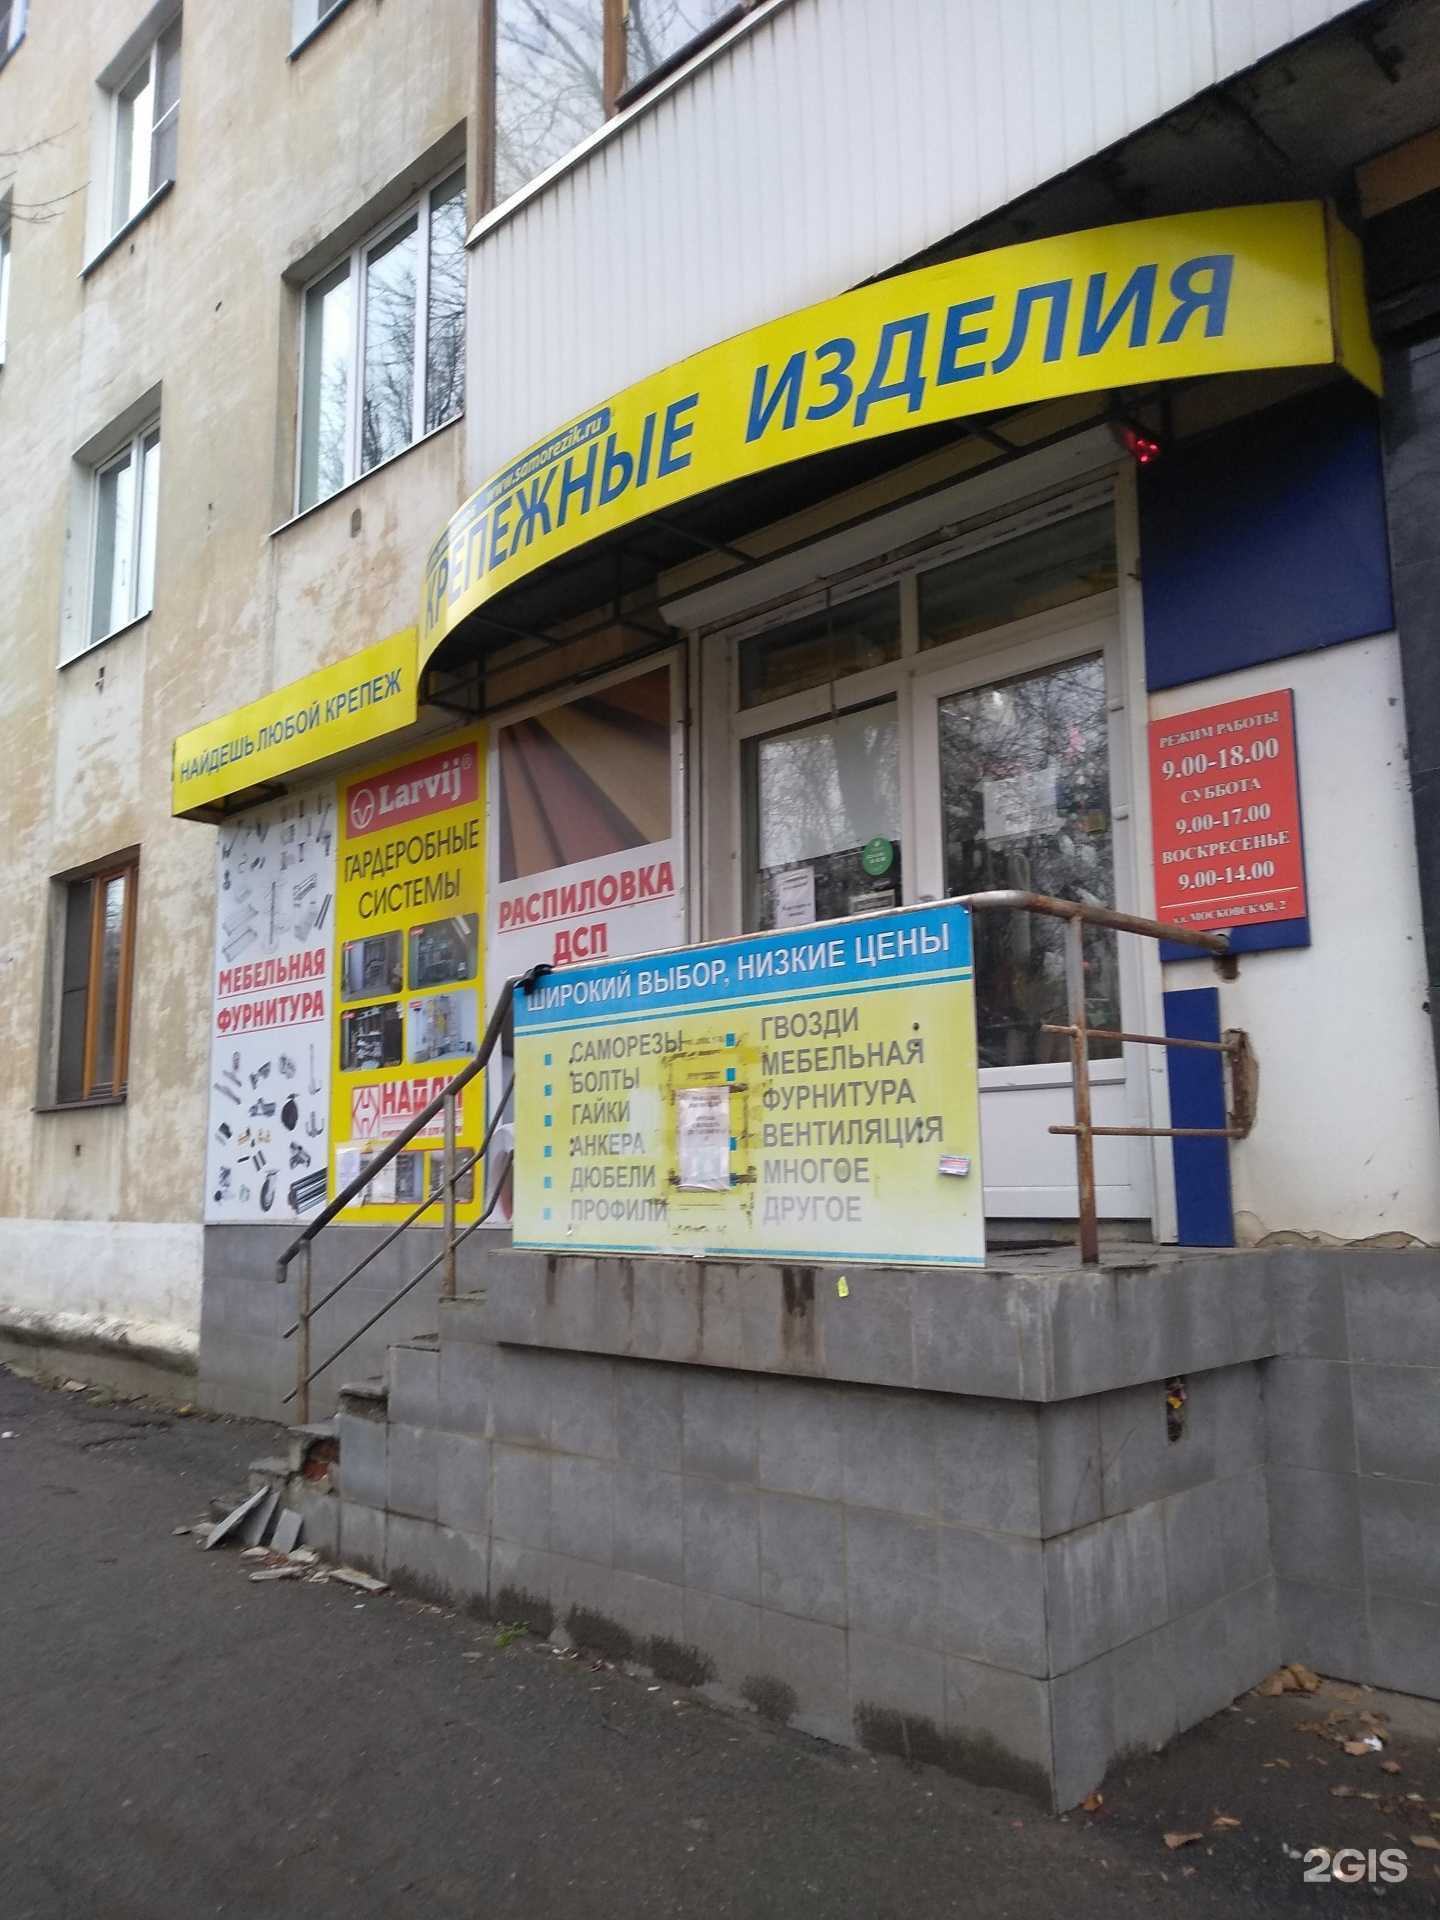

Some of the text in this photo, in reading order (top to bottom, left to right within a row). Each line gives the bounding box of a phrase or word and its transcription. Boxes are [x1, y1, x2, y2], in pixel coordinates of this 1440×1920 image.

[425, 254, 1235, 636] КРЕПЕЖНЫЕ ИЗДЕЛИЯ
[179, 668, 402, 784] НАЙДЕШЬ ЛЮБОЙ КРЕПЕЖ
[1159, 711, 1280, 749] РЕЖИМ РАБОТЫ
[1161, 737, 1280, 781] 9.00-18.00
[1180, 777, 1262, 804] СУББОТА
[1175, 803, 1271, 835] 9.00-17.00
[344, 818, 481, 883] ГАРДЕРОБНЫЕ
[1162, 830, 1289, 865] ВОСКРЕСЕНЬЕ
[1178, 860, 1275, 891] 9.00-14.00
[358, 869, 461, 921] СИСТЕМЫ
[498, 861, 675, 930] РАСПИЛОВКА
[552, 923, 609, 965] ДСП
[218, 947, 327, 995] МЕБЕЛЬНАЯ
[527, 923, 950, 1012] ШИРОКИЙ ВЫБОР, НИЗКИЕ ЦЕНЫ
[217, 989, 325, 1033] ФУРНИТУРА
[761, 1007, 859, 1042] ГВОЗДИ
[571, 1029, 683, 1062] САМОРЕЗЫ
[761, 1039, 925, 1075] МЕБЕЛЬНАЯ
[572, 1065, 640, 1094] БОЛТЫ
[762, 1077, 915, 1112] ФУРНИТУРА
[572, 1098, 631, 1125] ГАЙКИ
[572, 1128, 646, 1157] АНКЕРА
[763, 1115, 944, 1148] ВЕНТИЛЯЦИЯ
[570, 1164, 656, 1193] ДЮБЕЛИ
[763, 1156, 870, 1185] МНОГОЕ
[571, 1196, 668, 1222] ПРОФИЛИ
[762, 1196, 863, 1225] ДРУГОЕ
